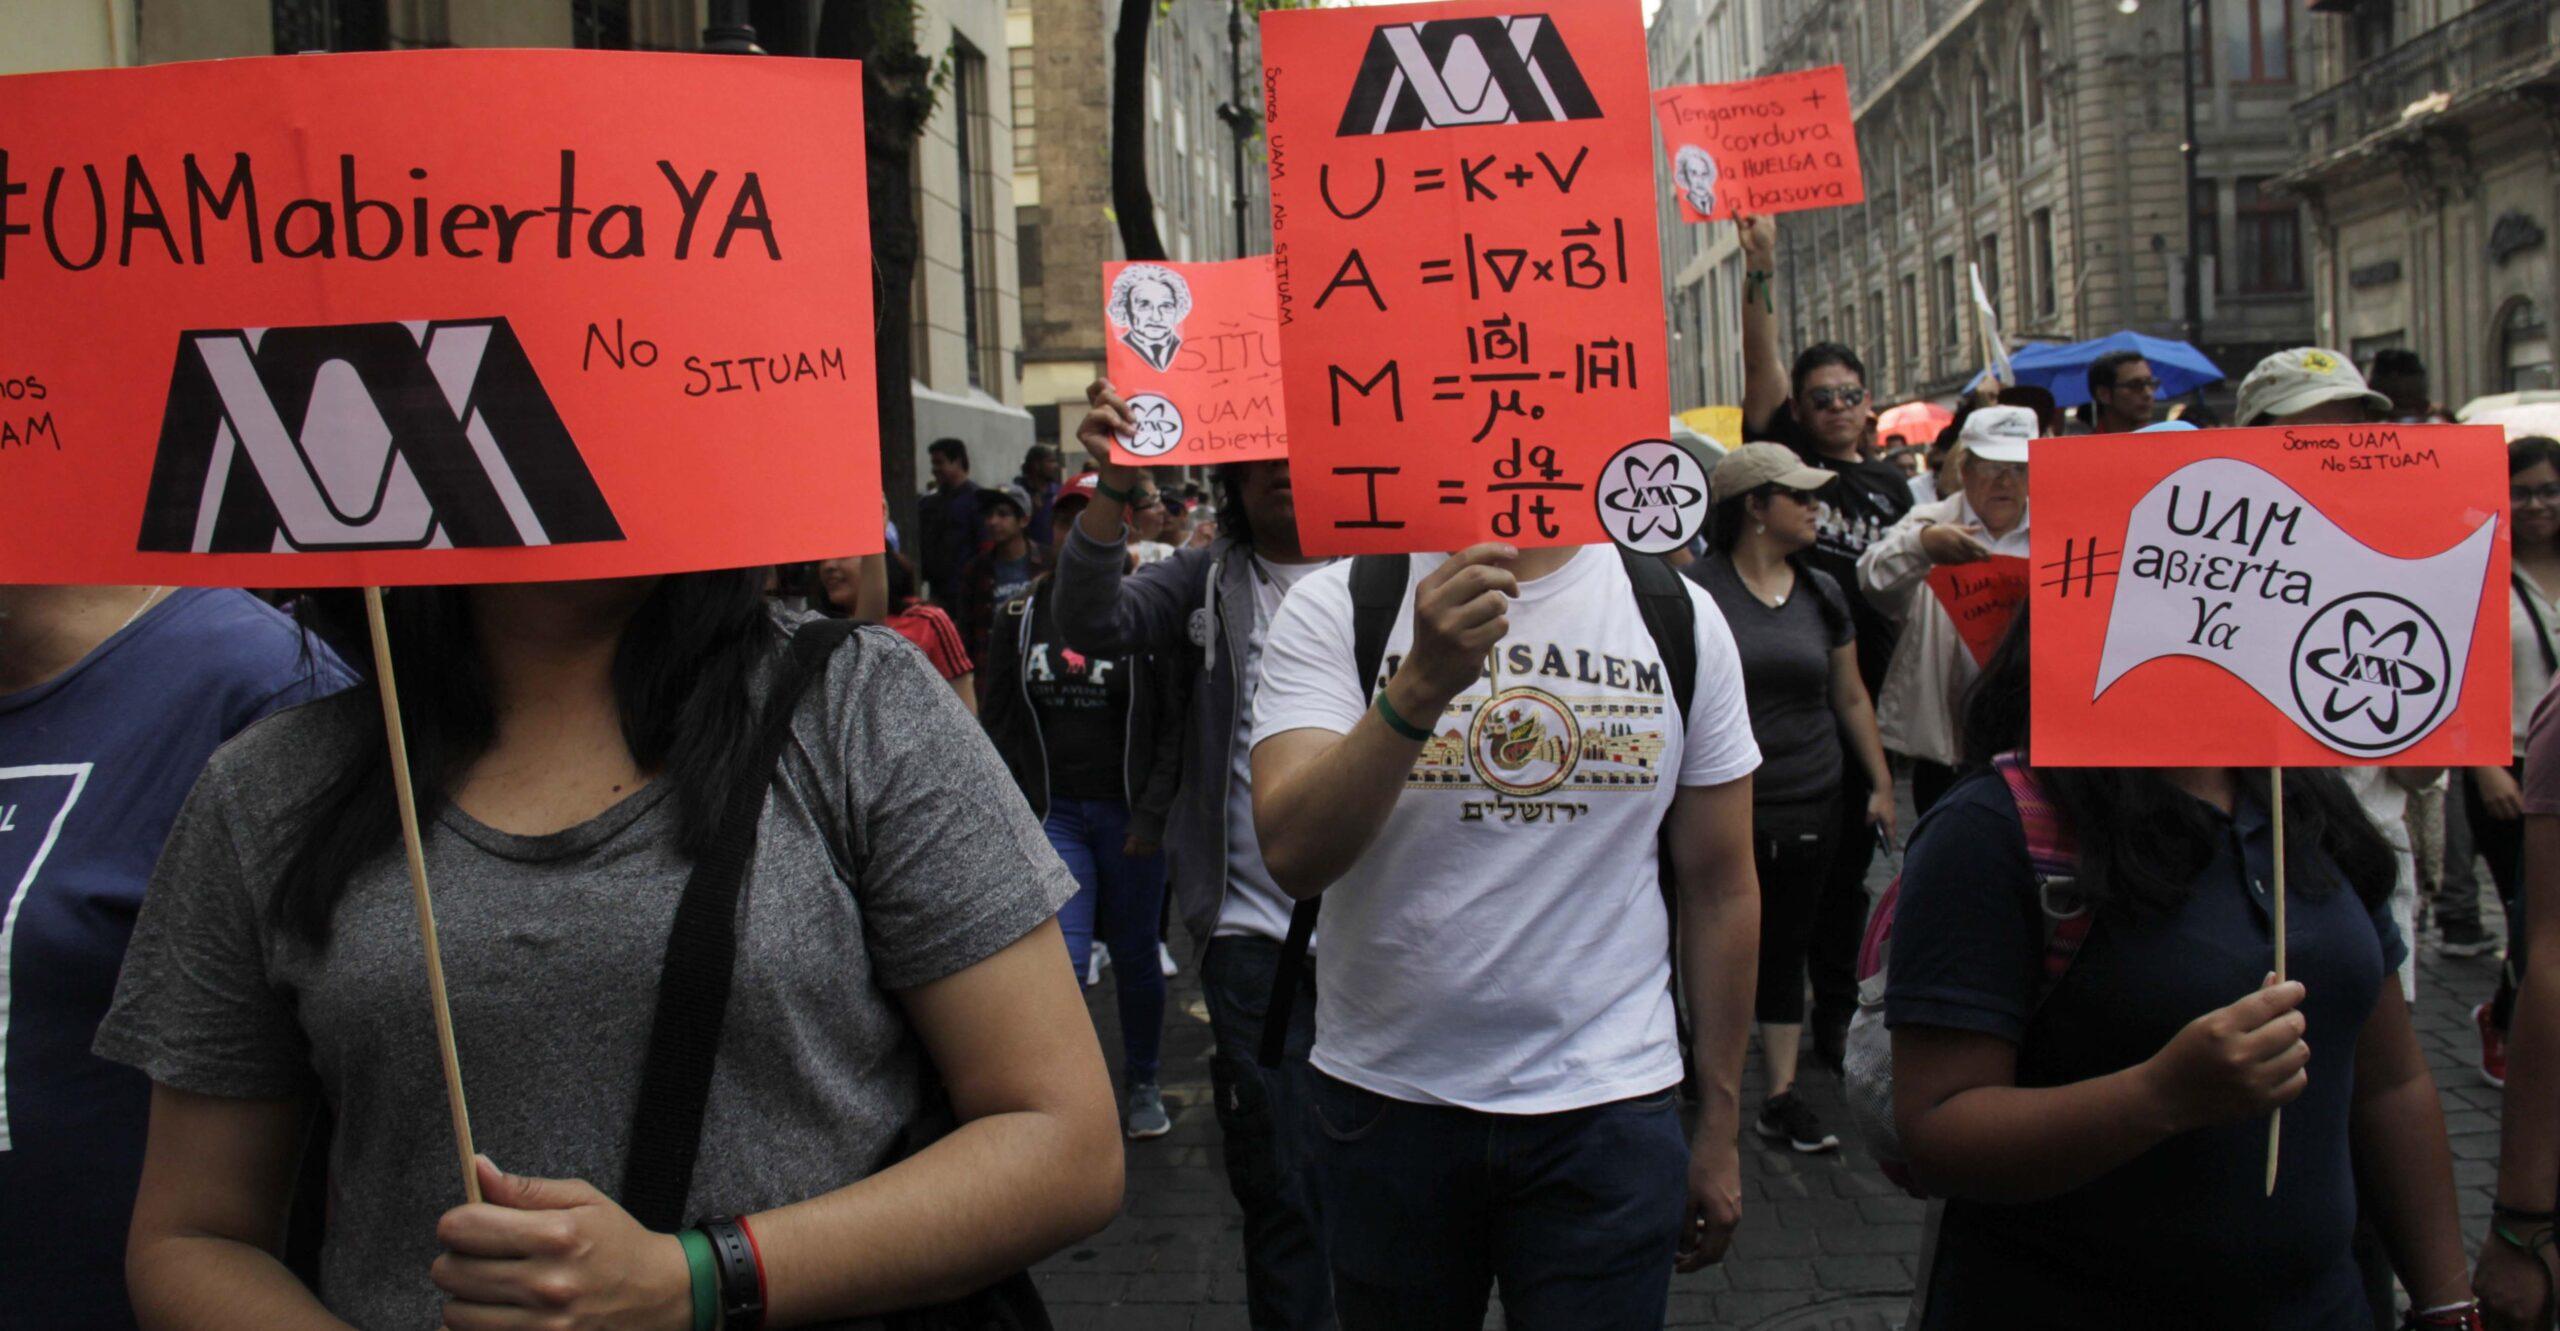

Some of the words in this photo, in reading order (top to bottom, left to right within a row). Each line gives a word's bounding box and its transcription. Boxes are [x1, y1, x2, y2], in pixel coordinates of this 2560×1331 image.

[1659, 95, 1786, 140] Tengamos
[1721, 123, 1832, 151] cordura
[1742, 153, 1818, 178] HUELGA
[1748, 181, 1844, 208] basura
[583, 318, 659, 372] No
[683, 347, 846, 398] SITUAM
[1197, 395, 1274, 424] UAM
[2283, 430, 2341, 451] Somos
[2349, 431, 2401, 451] UAM
[2349, 449, 2440, 470] SITUAM
[1460, 794, 1589, 823] ירושלים
